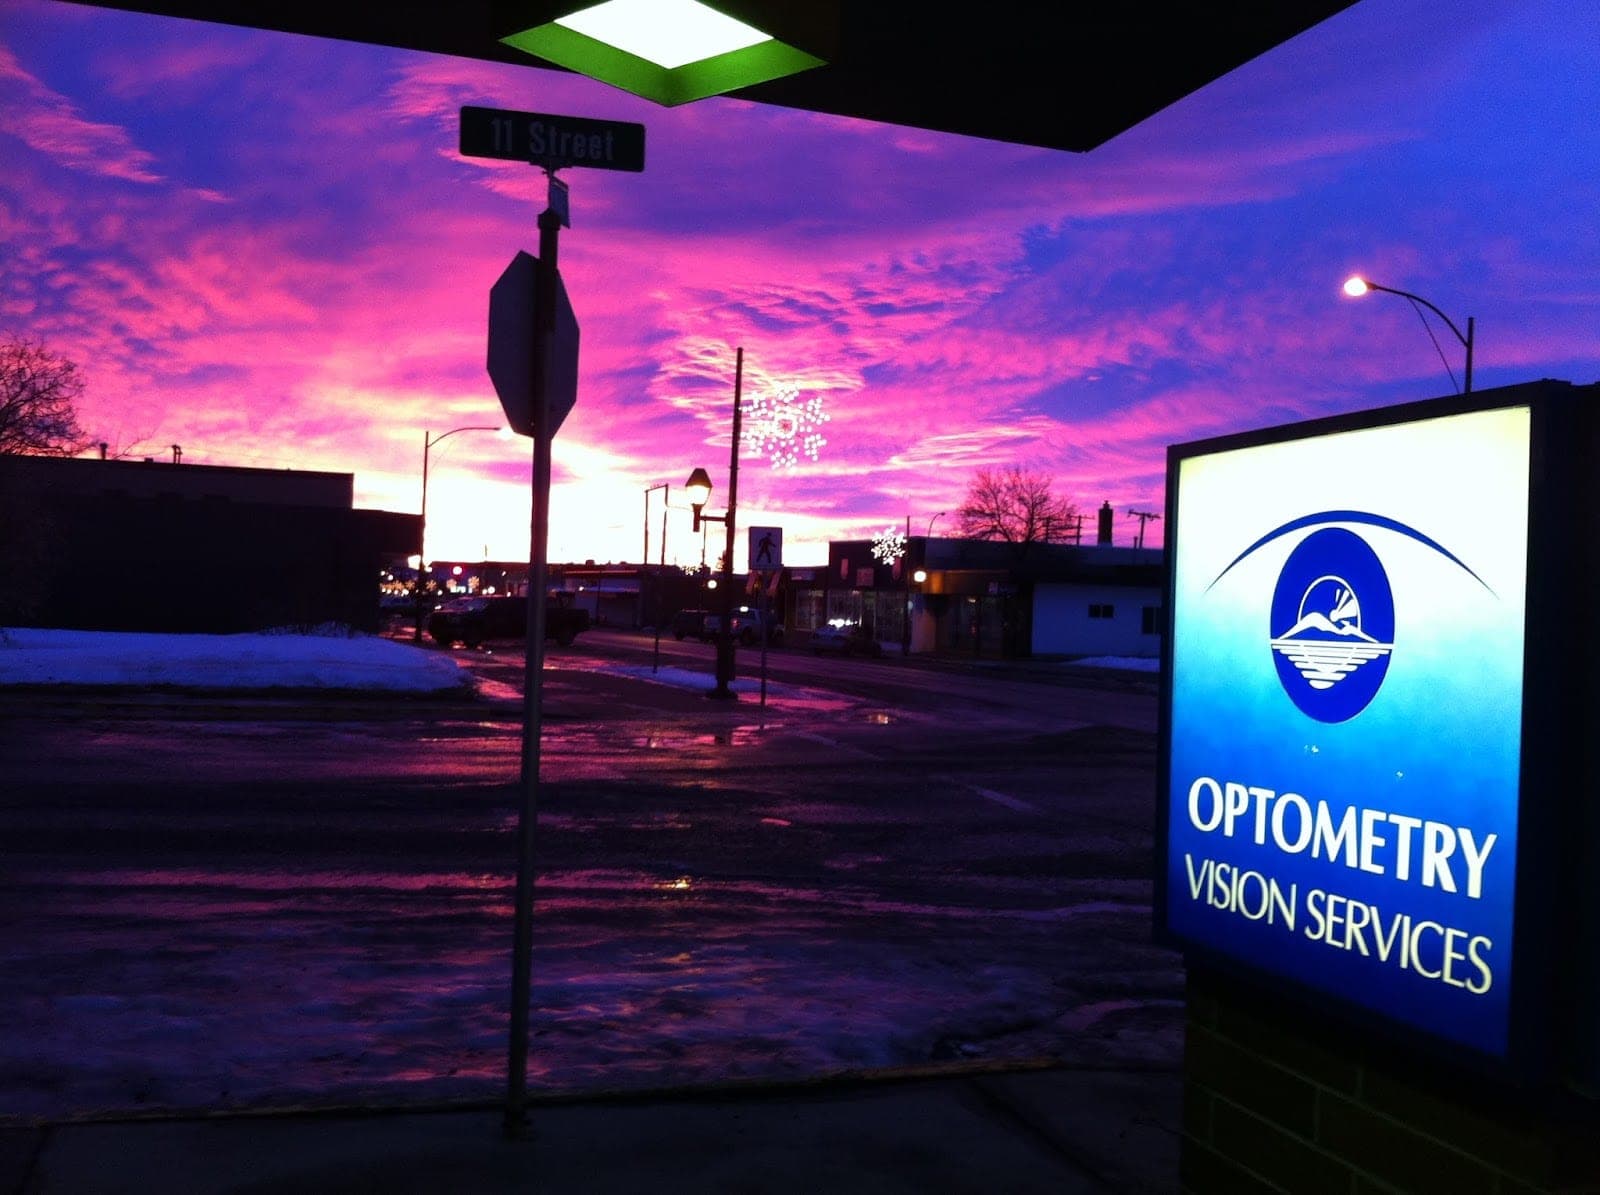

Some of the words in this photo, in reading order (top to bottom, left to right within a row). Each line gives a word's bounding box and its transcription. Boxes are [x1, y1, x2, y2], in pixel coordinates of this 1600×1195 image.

[489, 117, 513, 153] 11
[528, 120, 616, 161] Street
[1188, 776, 1498, 899] OPTOMETRY
[1185, 853, 1298, 932] VISION
[1304, 889, 1493, 995] SERVICES
